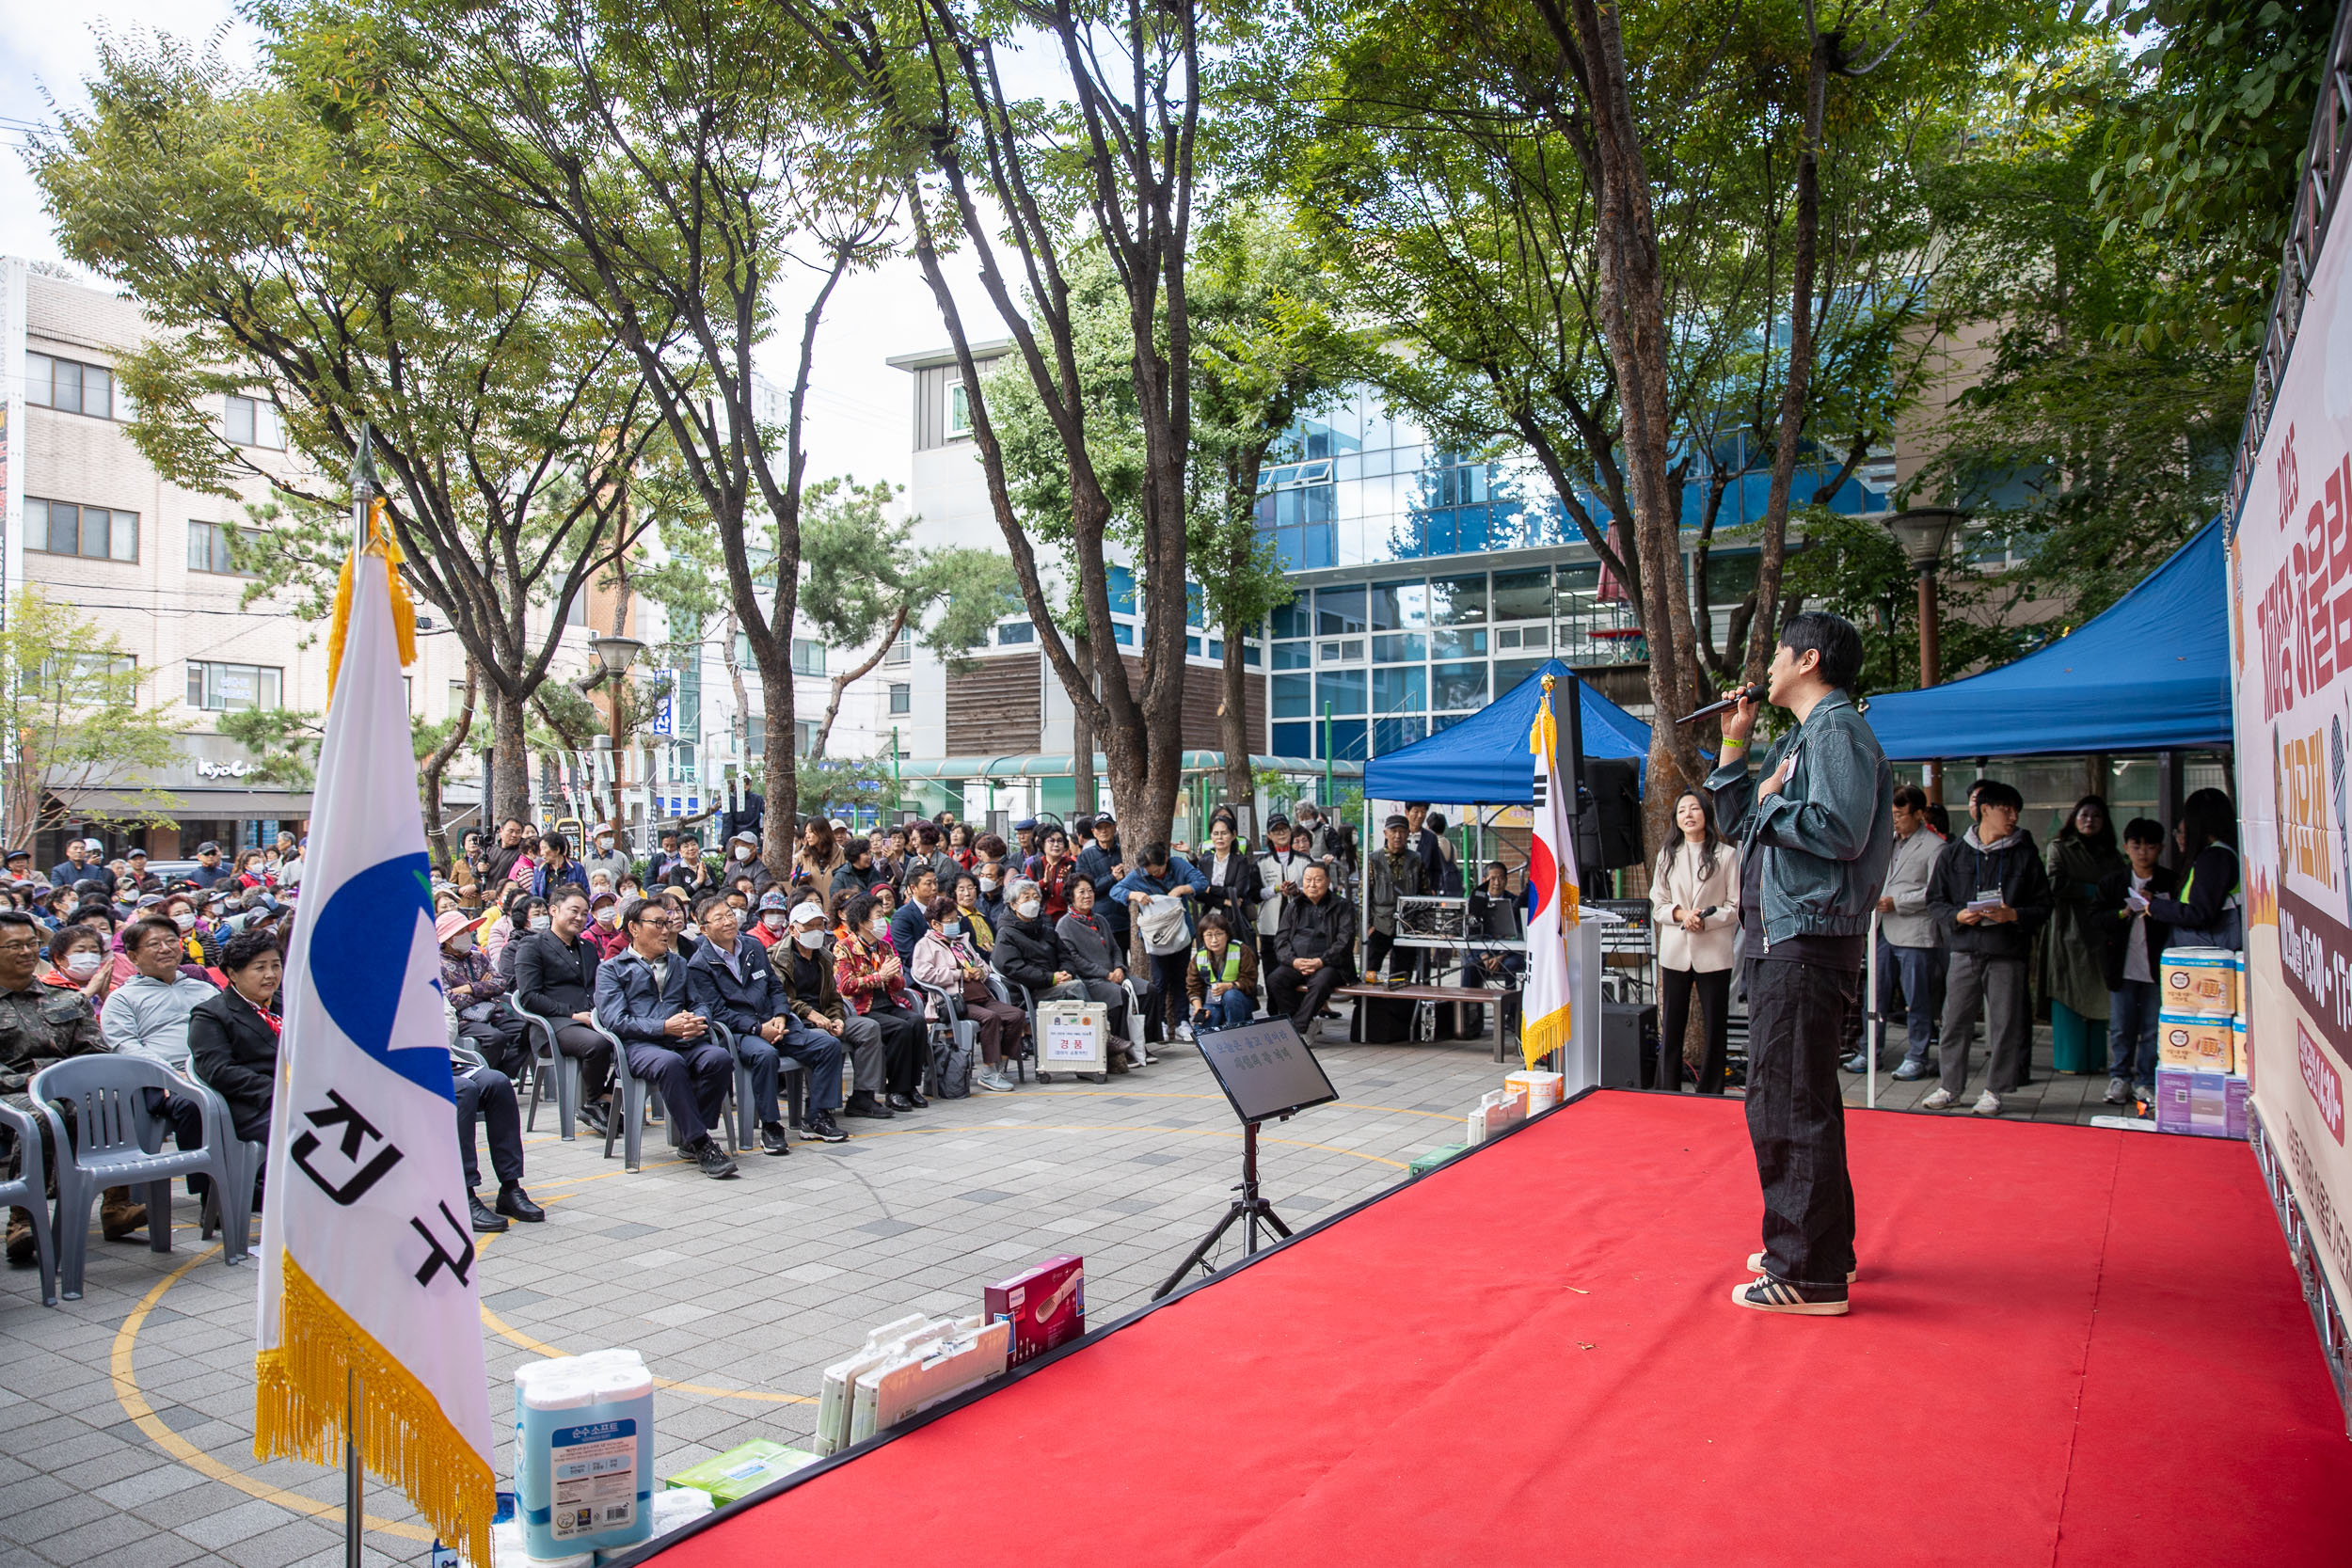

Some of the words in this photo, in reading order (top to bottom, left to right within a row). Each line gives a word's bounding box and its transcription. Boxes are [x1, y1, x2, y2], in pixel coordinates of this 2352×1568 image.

[2277, 420, 2299, 533] 2025
[2283, 727, 2331, 890] 가요제
[2301, 924, 2326, 1008] 15:00
[1010, 1293, 1024, 1302] PHILIPS
